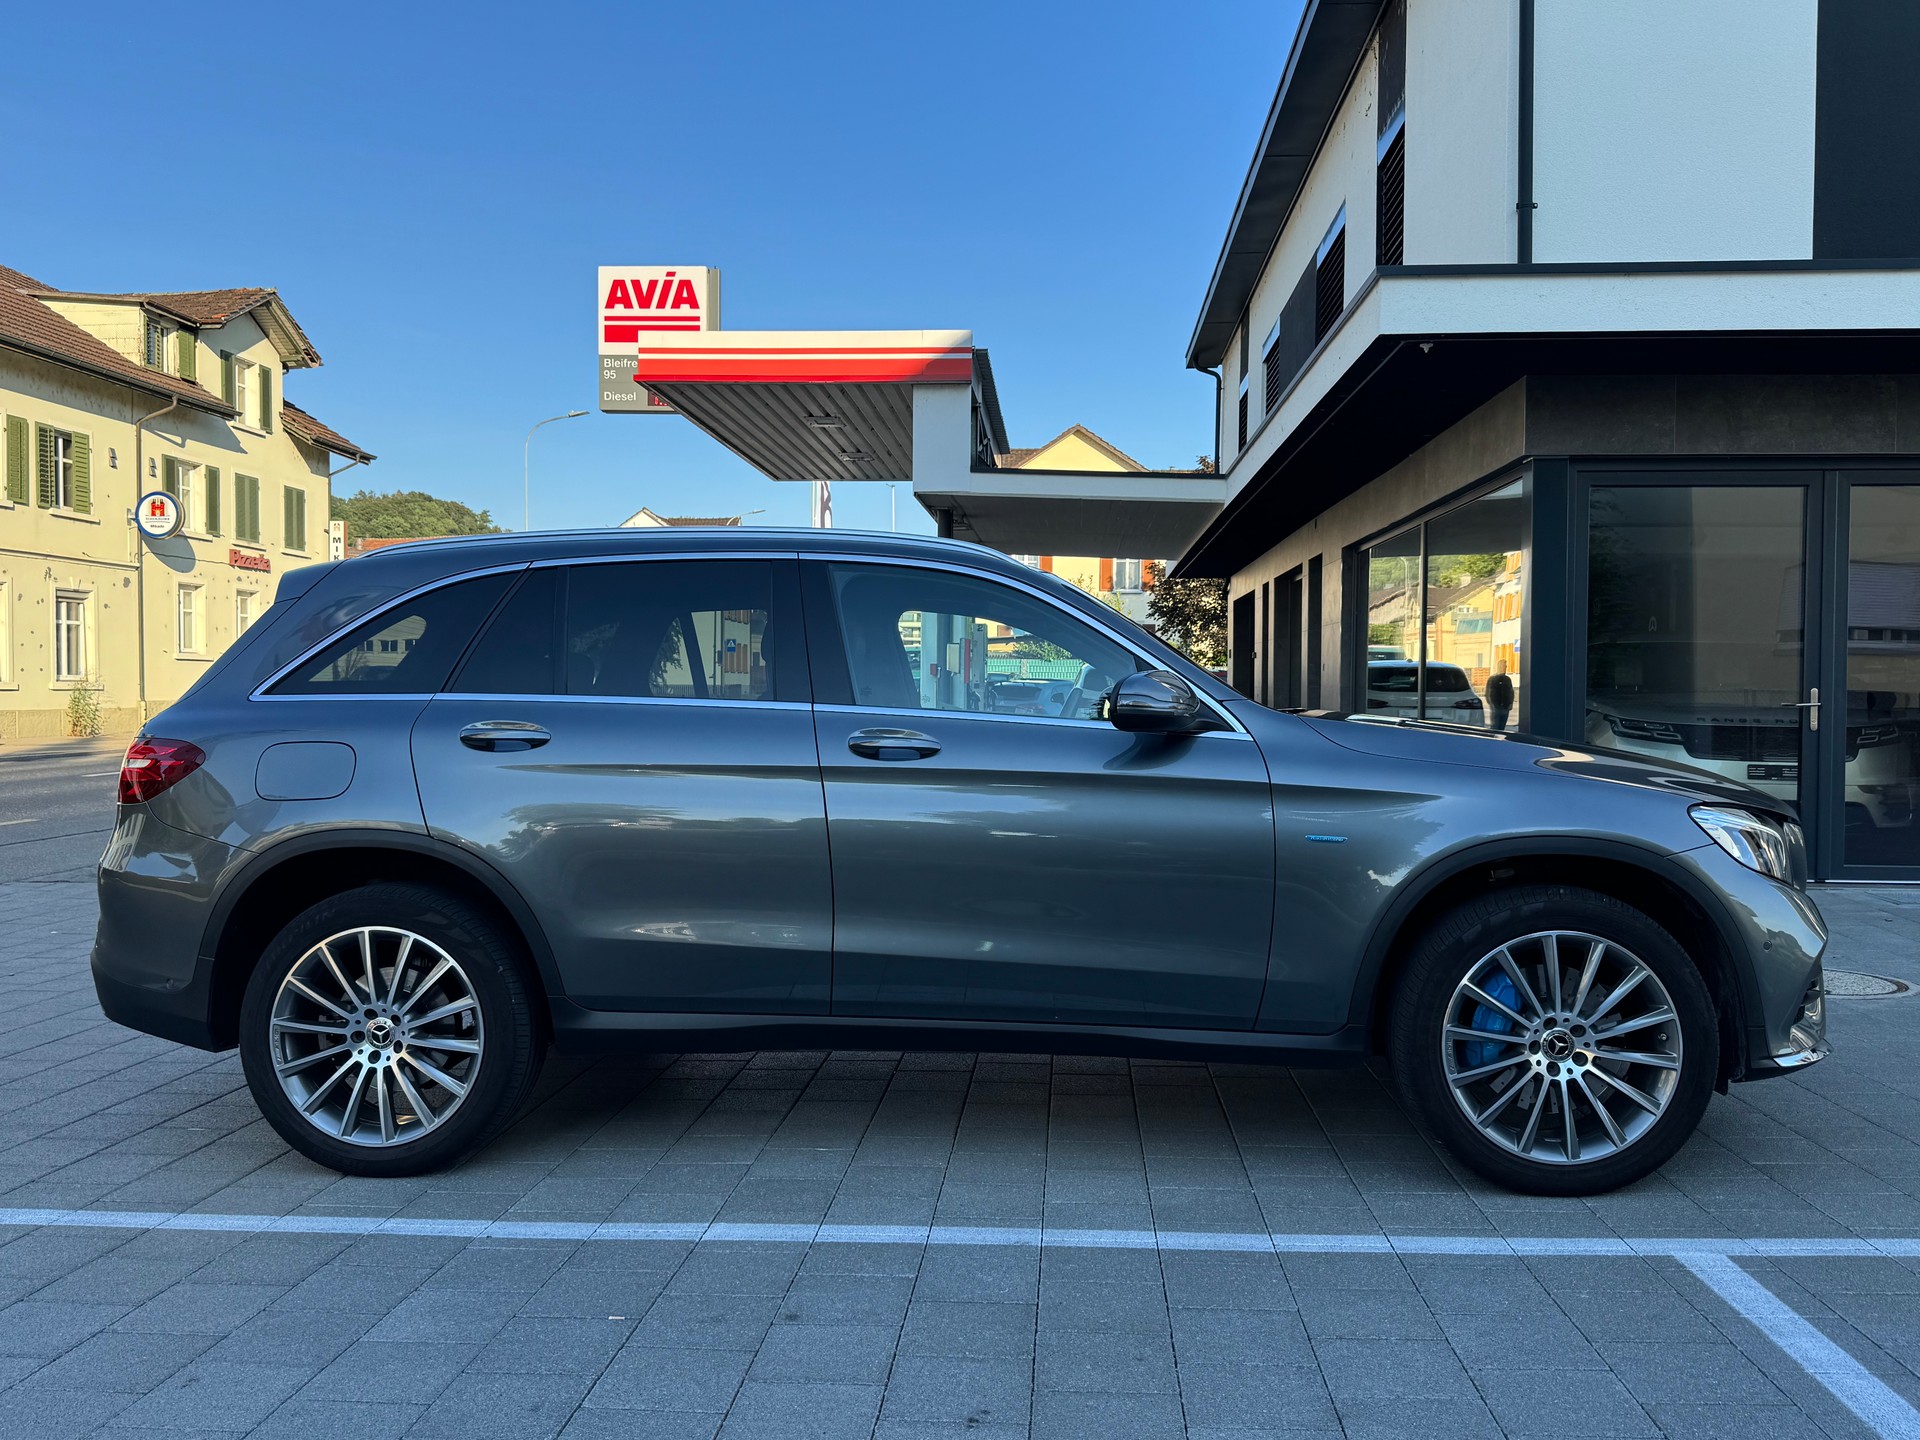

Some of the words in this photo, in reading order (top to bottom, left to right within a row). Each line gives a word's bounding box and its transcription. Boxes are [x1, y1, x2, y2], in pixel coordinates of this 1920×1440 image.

[603, 358, 638, 368] Bleifre
[603, 369, 617, 380] 95
[603, 391, 637, 401] Diesel
[977, 624, 984, 632] 2
